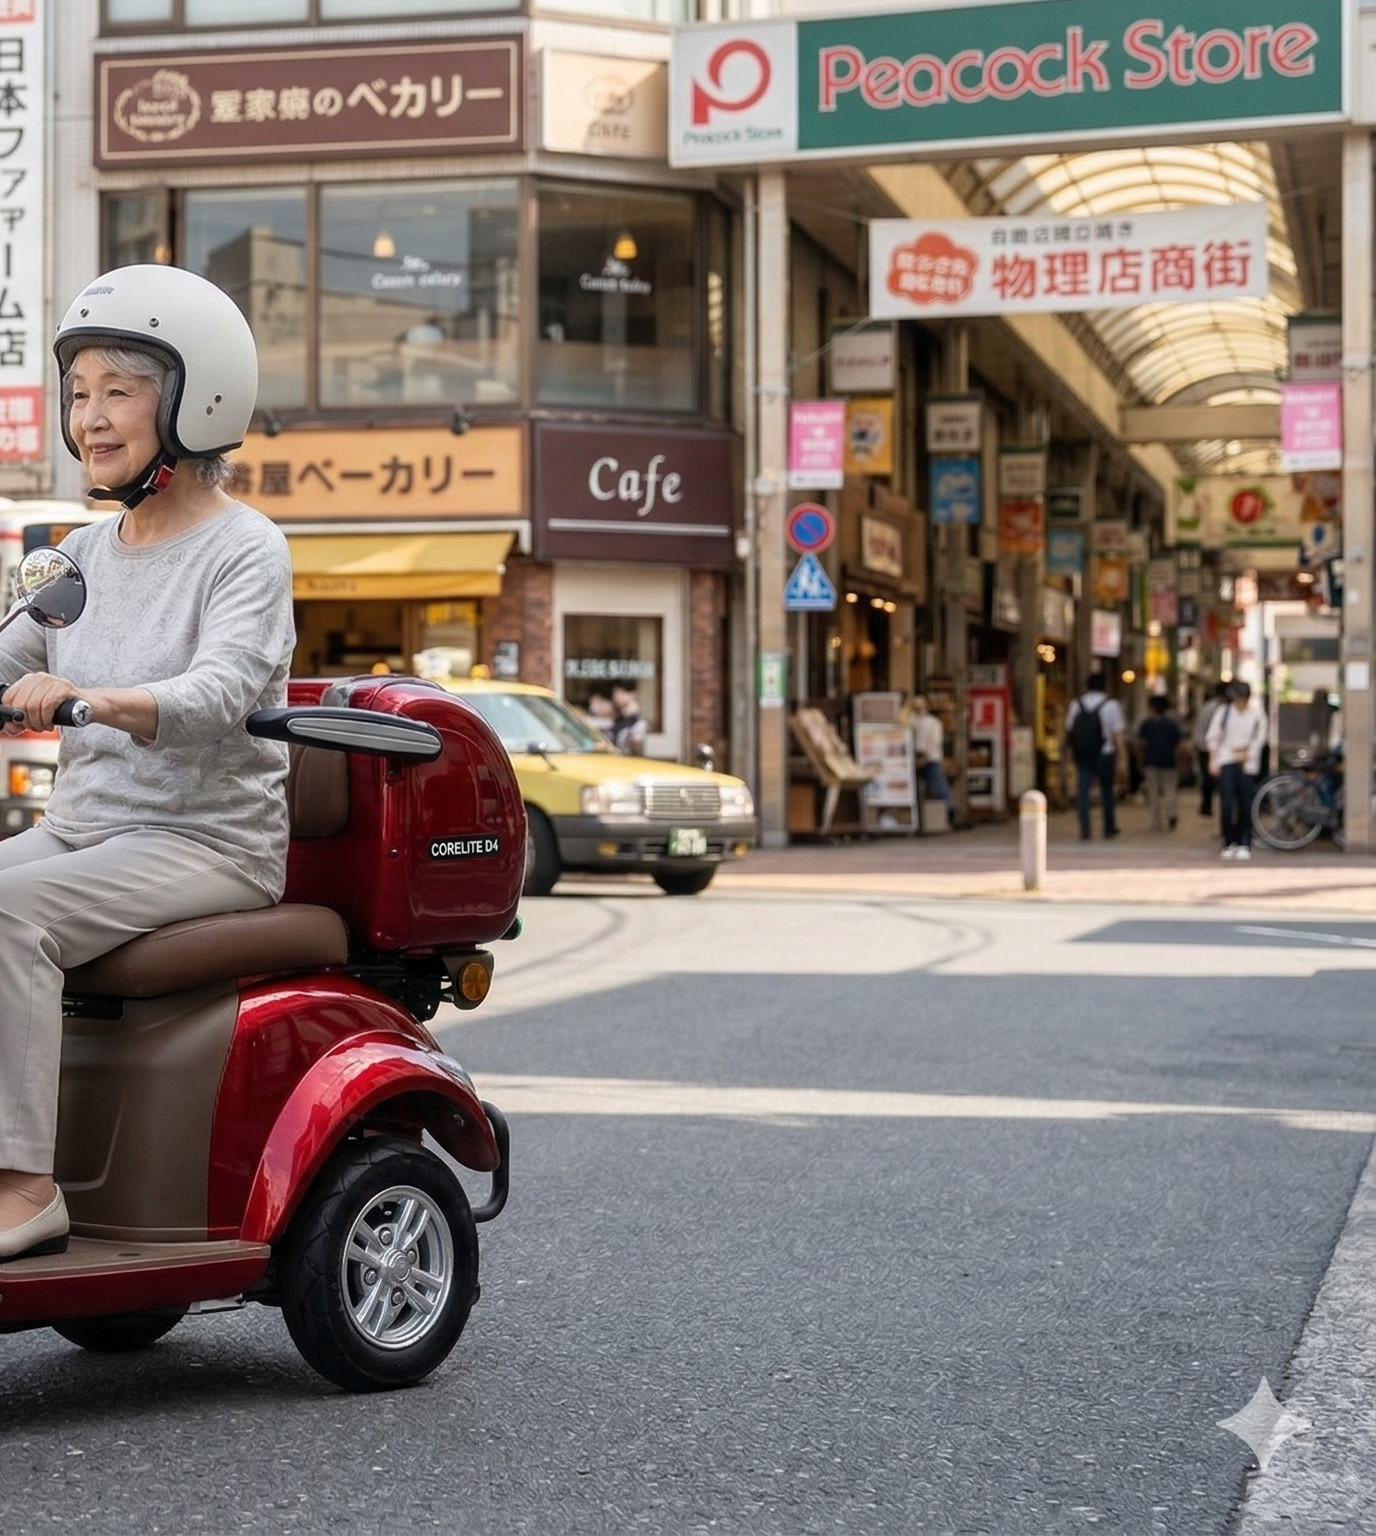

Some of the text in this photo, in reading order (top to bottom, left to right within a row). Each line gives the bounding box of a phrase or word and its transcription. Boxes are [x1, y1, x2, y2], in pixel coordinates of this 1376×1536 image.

[818, 18, 1319, 112] Peacock Store
[991, 239, 1251, 300] 物理店商街
[588, 454, 683, 517] Cafe
[431, 838, 499, 857] CORELITE D4
